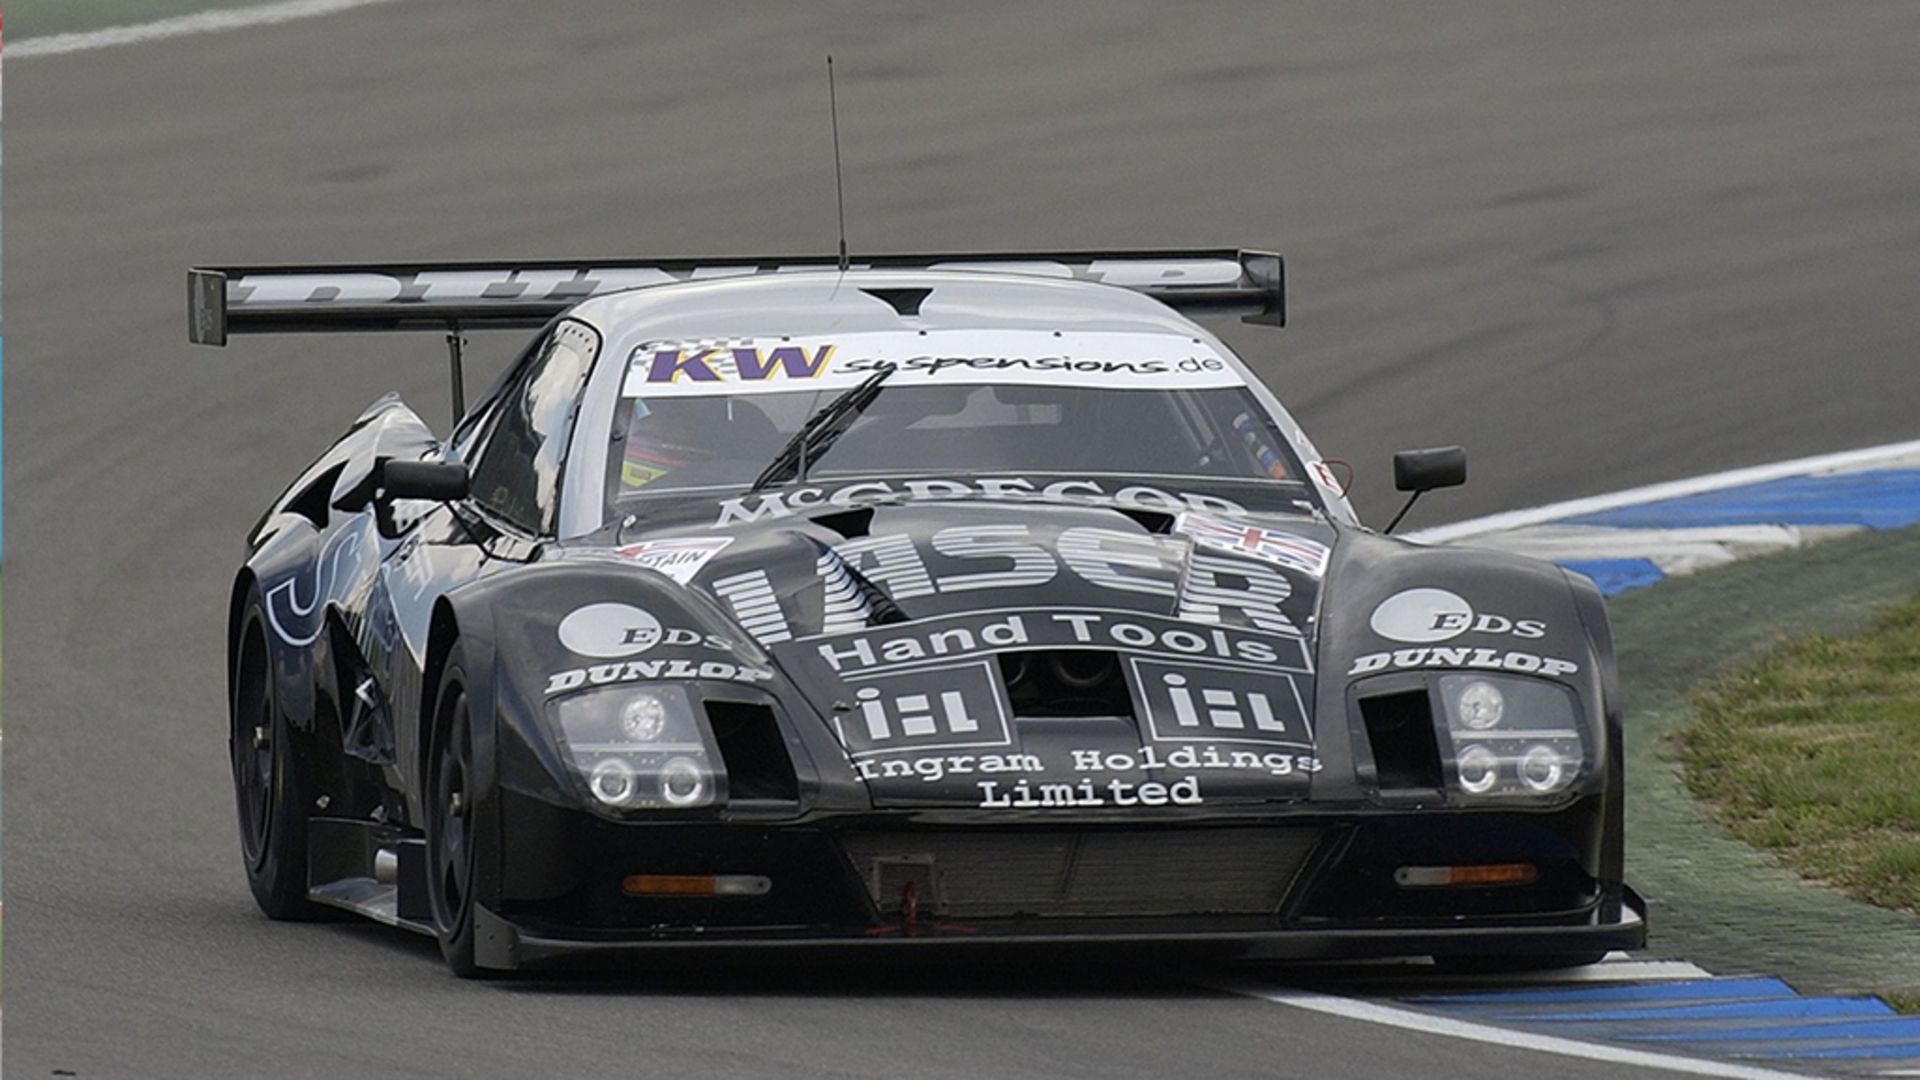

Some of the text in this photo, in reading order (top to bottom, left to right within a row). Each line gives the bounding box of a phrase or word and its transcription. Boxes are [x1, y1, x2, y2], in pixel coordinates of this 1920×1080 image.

[646, 344, 838, 384] KW
[619, 628, 733, 651] EDS
[818, 614, 1277, 672] Hand Tools
[1429, 613, 1546, 639] EDS
[544, 660, 775, 695] DUNLOP
[1347, 648, 1578, 677] DUNLOP
[851, 746, 1322, 782] Ingram Holdings
[978, 775, 1203, 809] Limited
